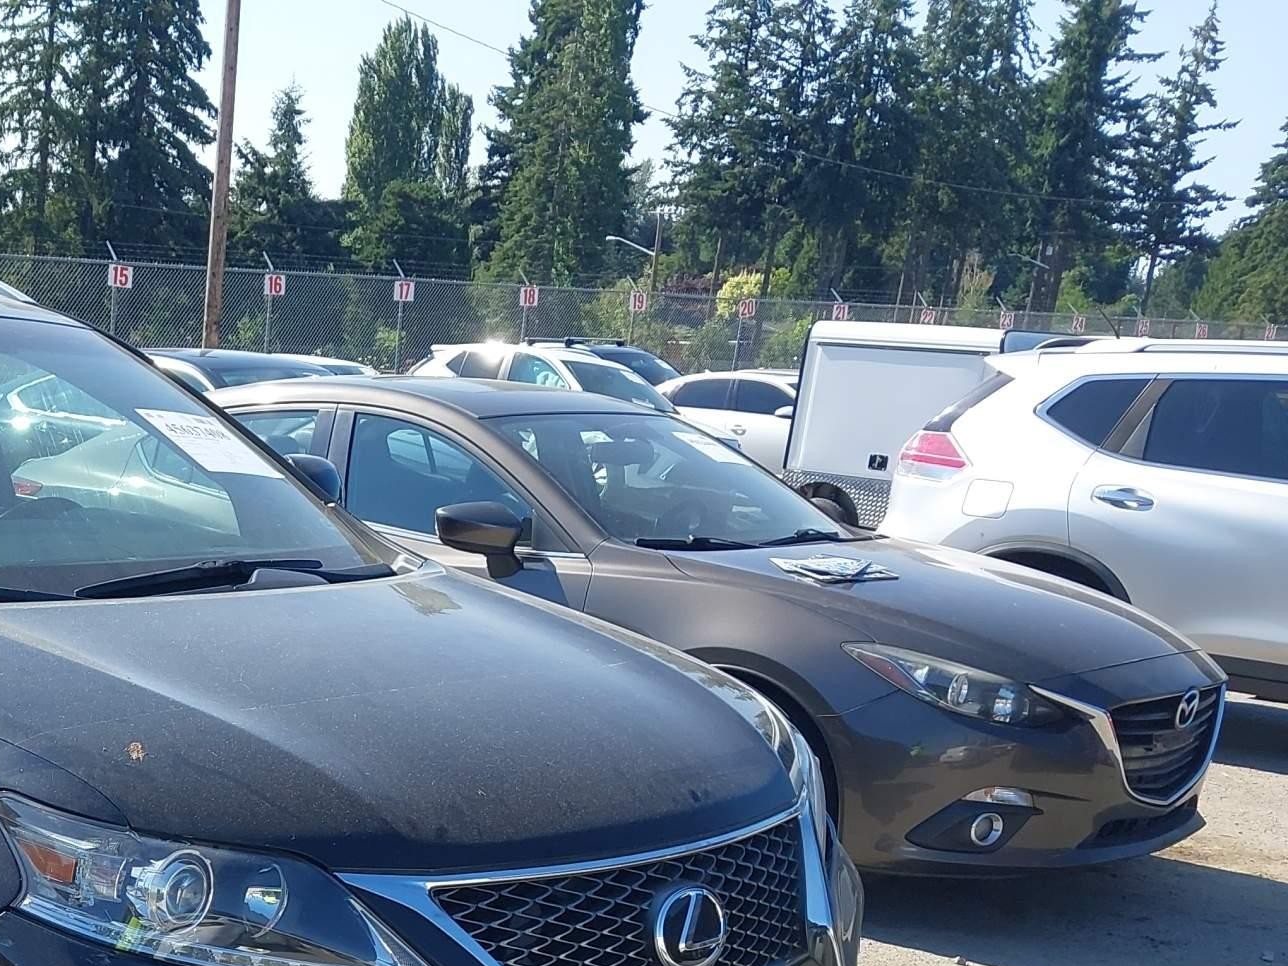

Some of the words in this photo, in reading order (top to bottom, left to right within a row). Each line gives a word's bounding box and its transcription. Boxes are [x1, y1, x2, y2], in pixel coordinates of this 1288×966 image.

[113, 266, 129, 287] 15
[268, 275, 282, 294] 16
[398, 282, 412, 300] 17
[523, 288, 536, 305] 18
[632, 294, 644, 310] 19
[741, 300, 754, 316] 20
[835, 305, 847, 320] 21
[922, 311, 934, 324] 22
[1001, 313, 1013, 328] 23
